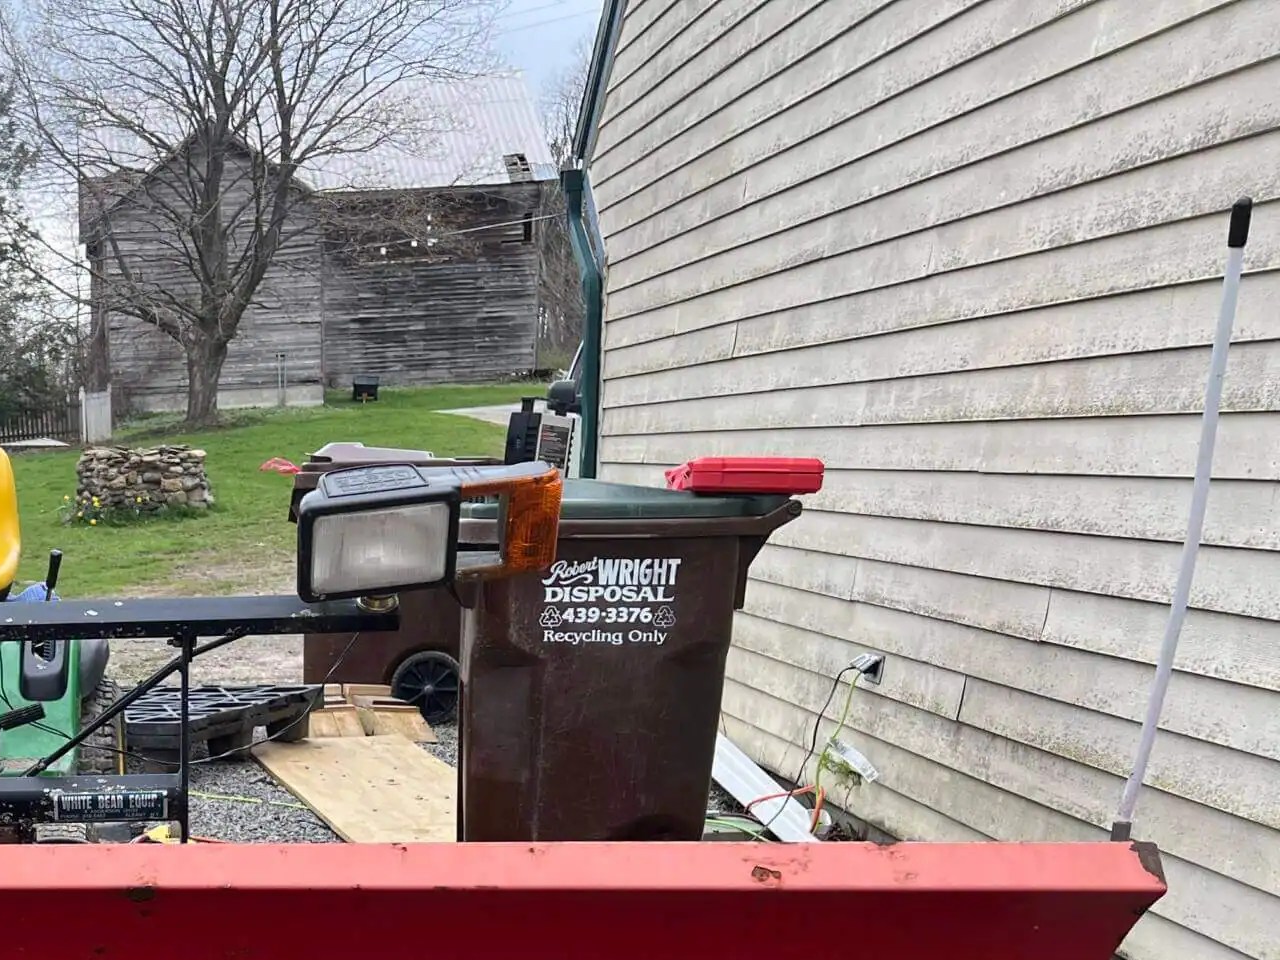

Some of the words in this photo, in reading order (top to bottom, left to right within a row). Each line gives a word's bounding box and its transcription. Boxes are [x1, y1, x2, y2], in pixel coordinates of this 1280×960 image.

[541, 556, 598, 586] Robert
[598, 558, 681, 586] WRIGHT
[543, 586, 675, 603] DISPOSAL
[543, 629, 623, 645] Recycling
[628, 629, 668, 645] Only
[61, 795, 92, 810] WHITE
[97, 794, 124, 809] BEAR
